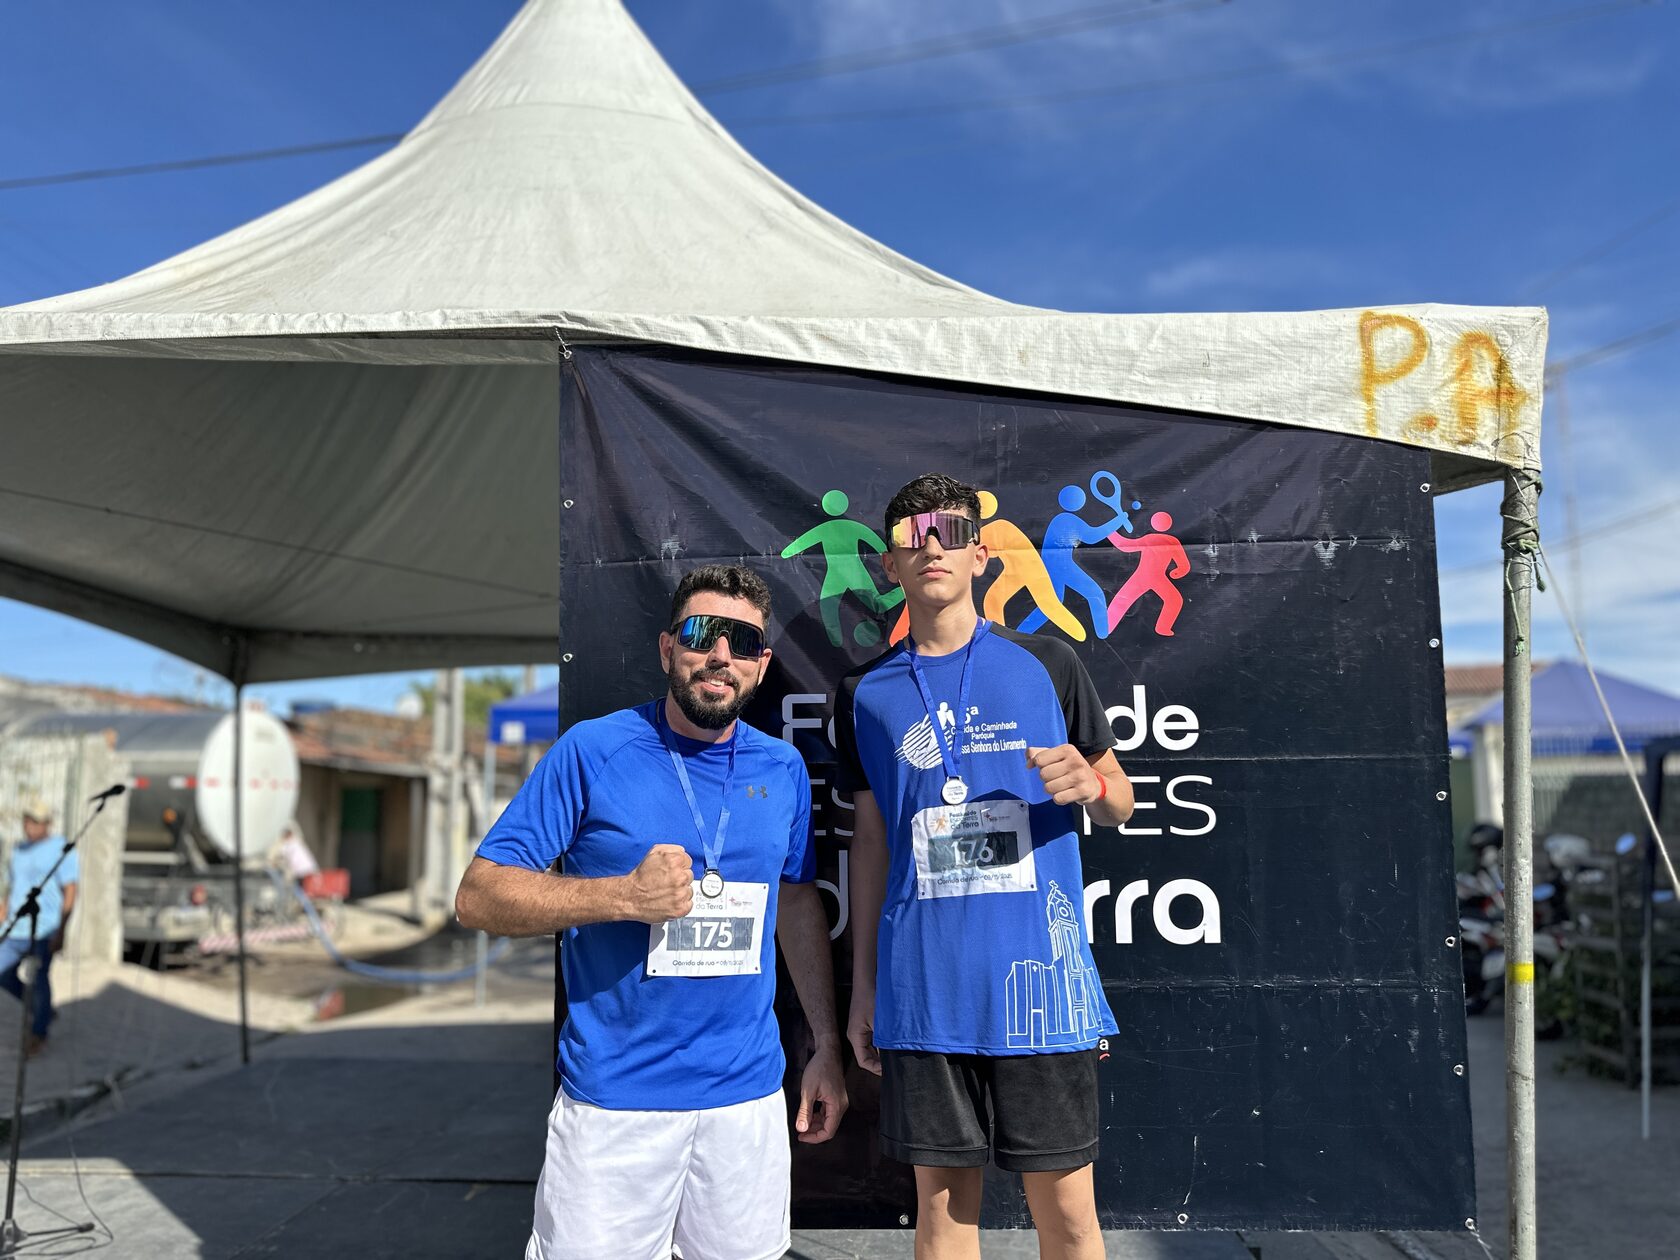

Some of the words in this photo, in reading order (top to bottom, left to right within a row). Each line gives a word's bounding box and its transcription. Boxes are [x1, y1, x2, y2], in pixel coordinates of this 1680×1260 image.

[981, 720, 1017, 732] Caminhada
[1104, 685, 1199, 751] de
[970, 740, 992, 753] Senhora
[992, 740, 999, 752] do
[1000, 738, 1027, 751] Livramento
[971, 732, 995, 741] Paróquia
[951, 837, 994, 866] 176
[691, 921, 733, 948] 175
